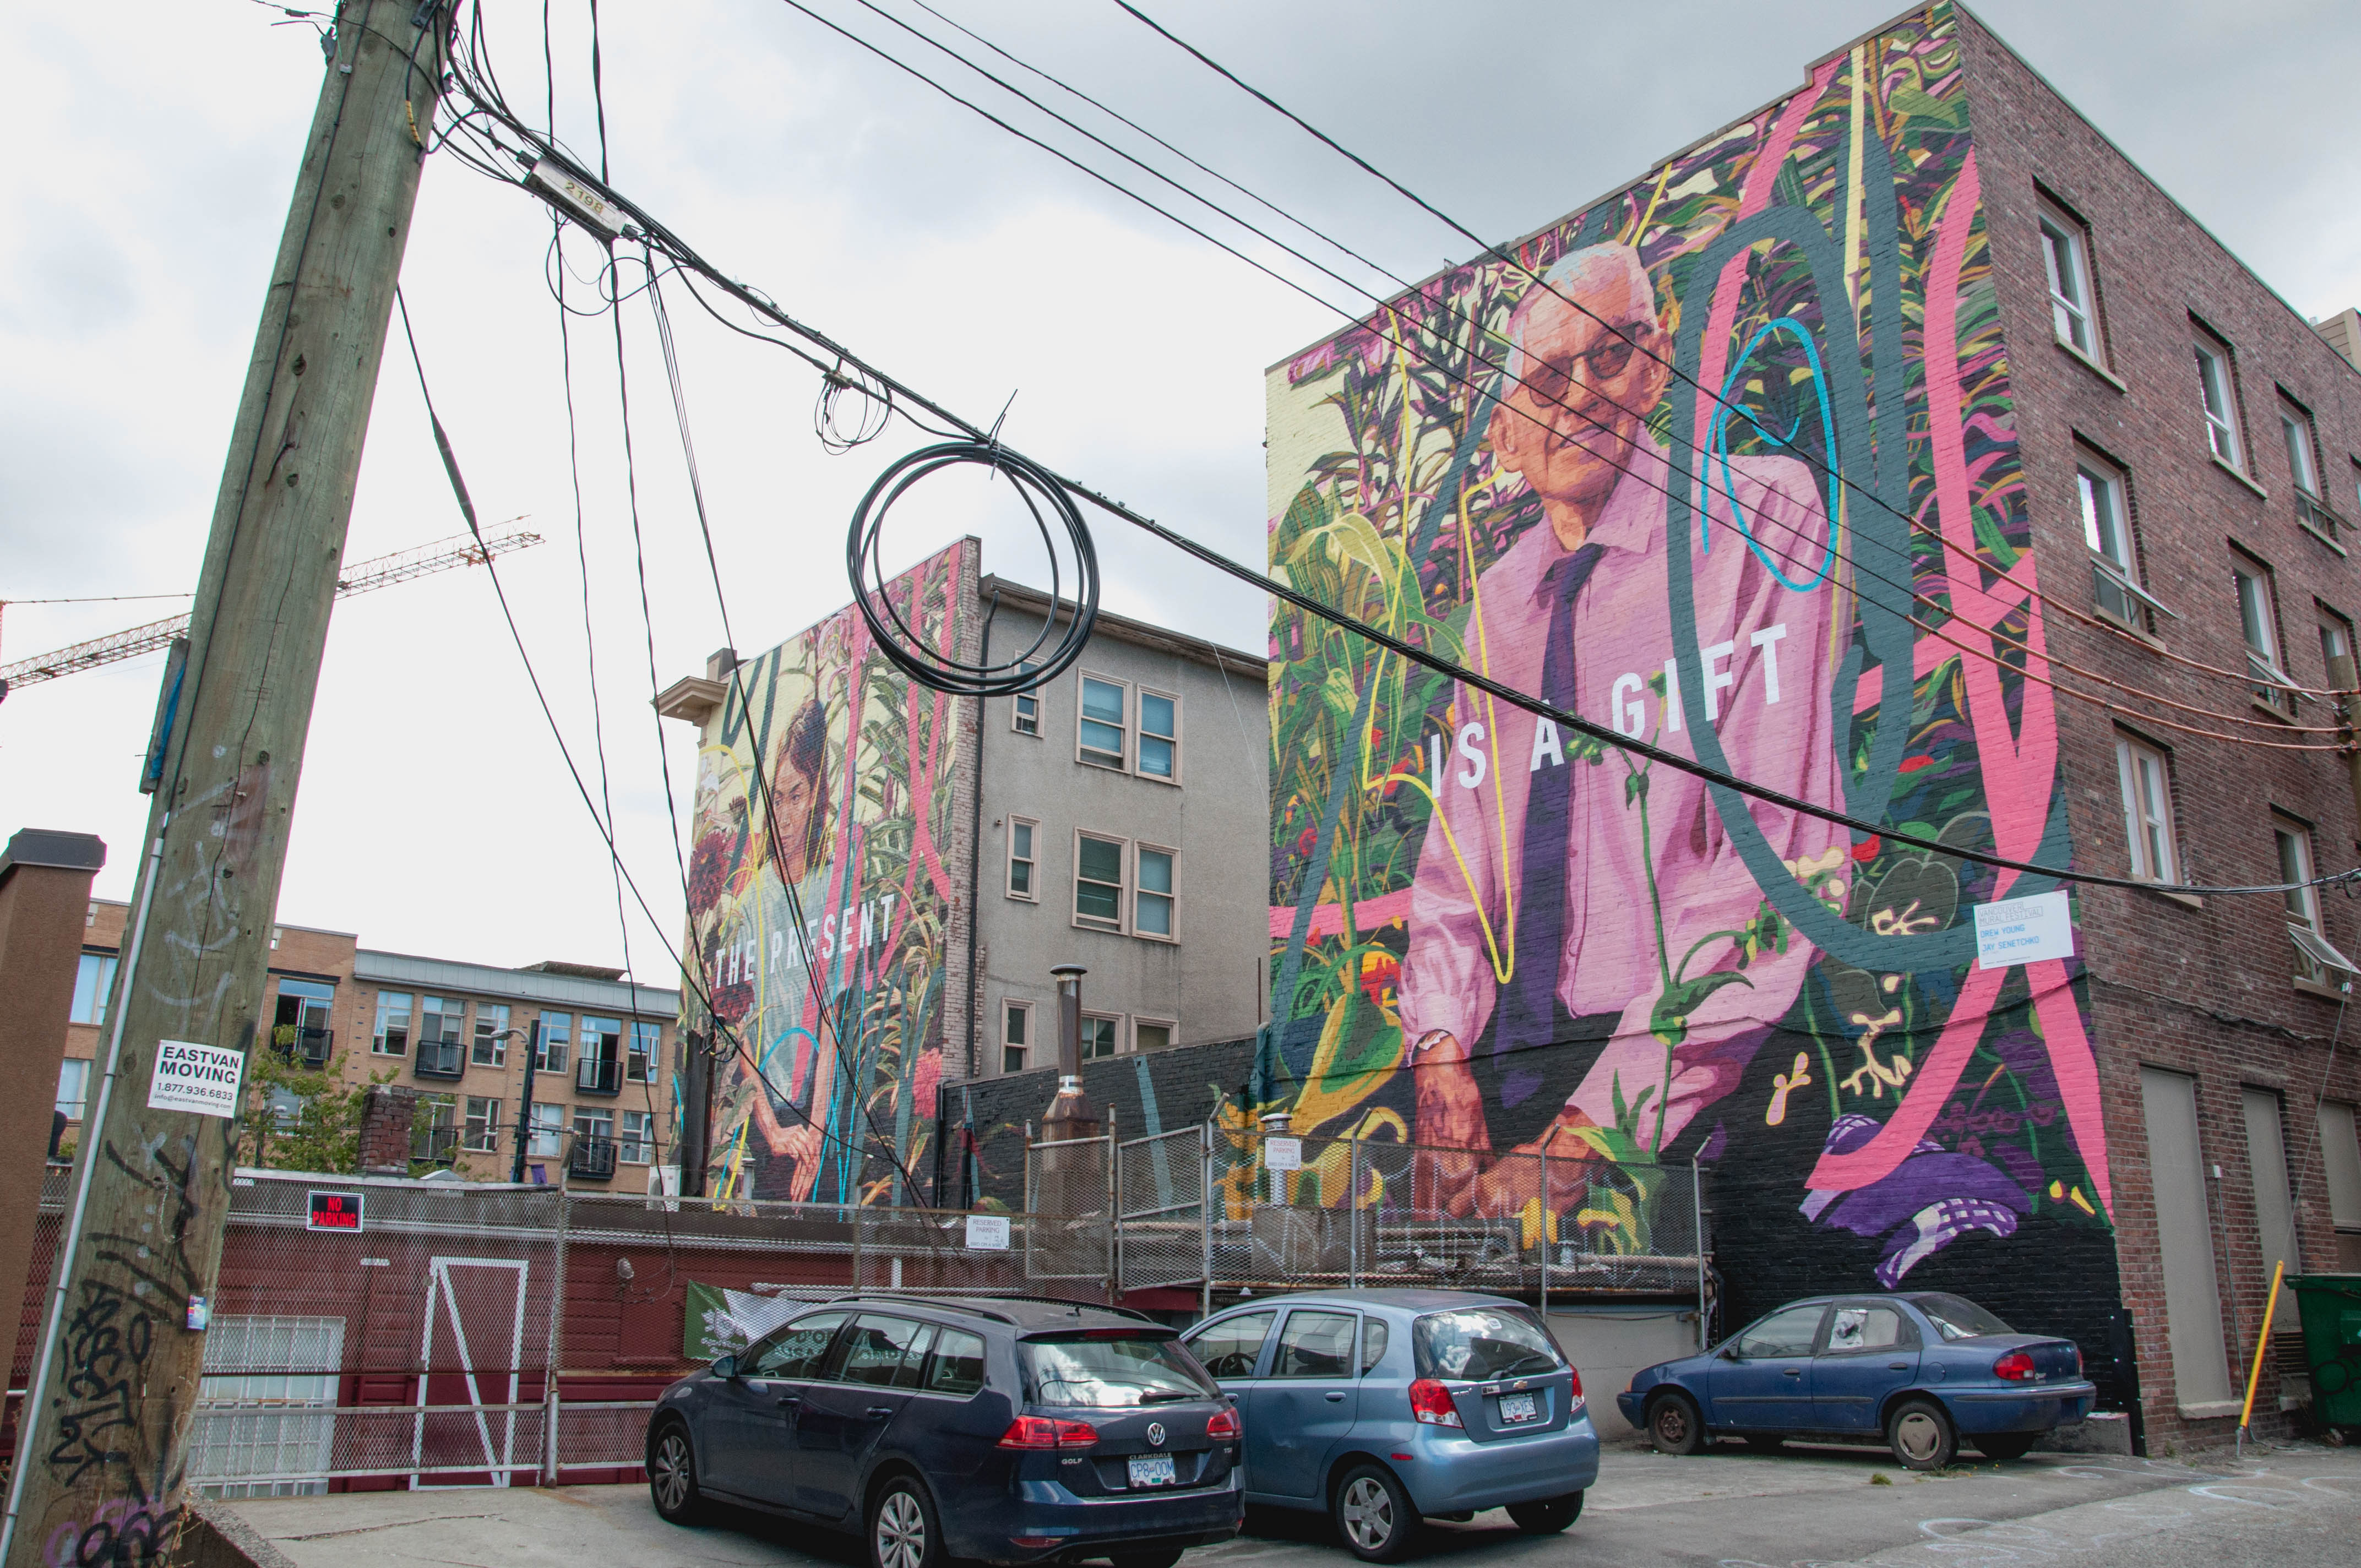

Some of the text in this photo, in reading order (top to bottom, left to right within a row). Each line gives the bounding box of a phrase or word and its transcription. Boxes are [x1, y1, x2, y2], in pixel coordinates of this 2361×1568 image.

[565, 180, 605, 215] 2198
[1430, 623, 1787, 798] IS A GIFT
[1979, 903, 2022, 917] VANCOUVER
[1979, 908, 2041, 925] MURAL FESTIVAL
[1980, 924, 2026, 939] DREW YOUNG
[715, 894, 895, 989] THE PRESENT
[1982, 935, 2039, 952] JAY SENETCHKO
[163, 1046, 240, 1069] EASTVAN
[160, 1060, 236, 1084] MOVING
[157, 1082, 233, 1101] 1.877.936.6833
[154, 1094, 231, 1109] info@eastvanmoving.com
[327, 1196, 342, 1212] NO
[312, 1211, 356, 1227] PARKING
